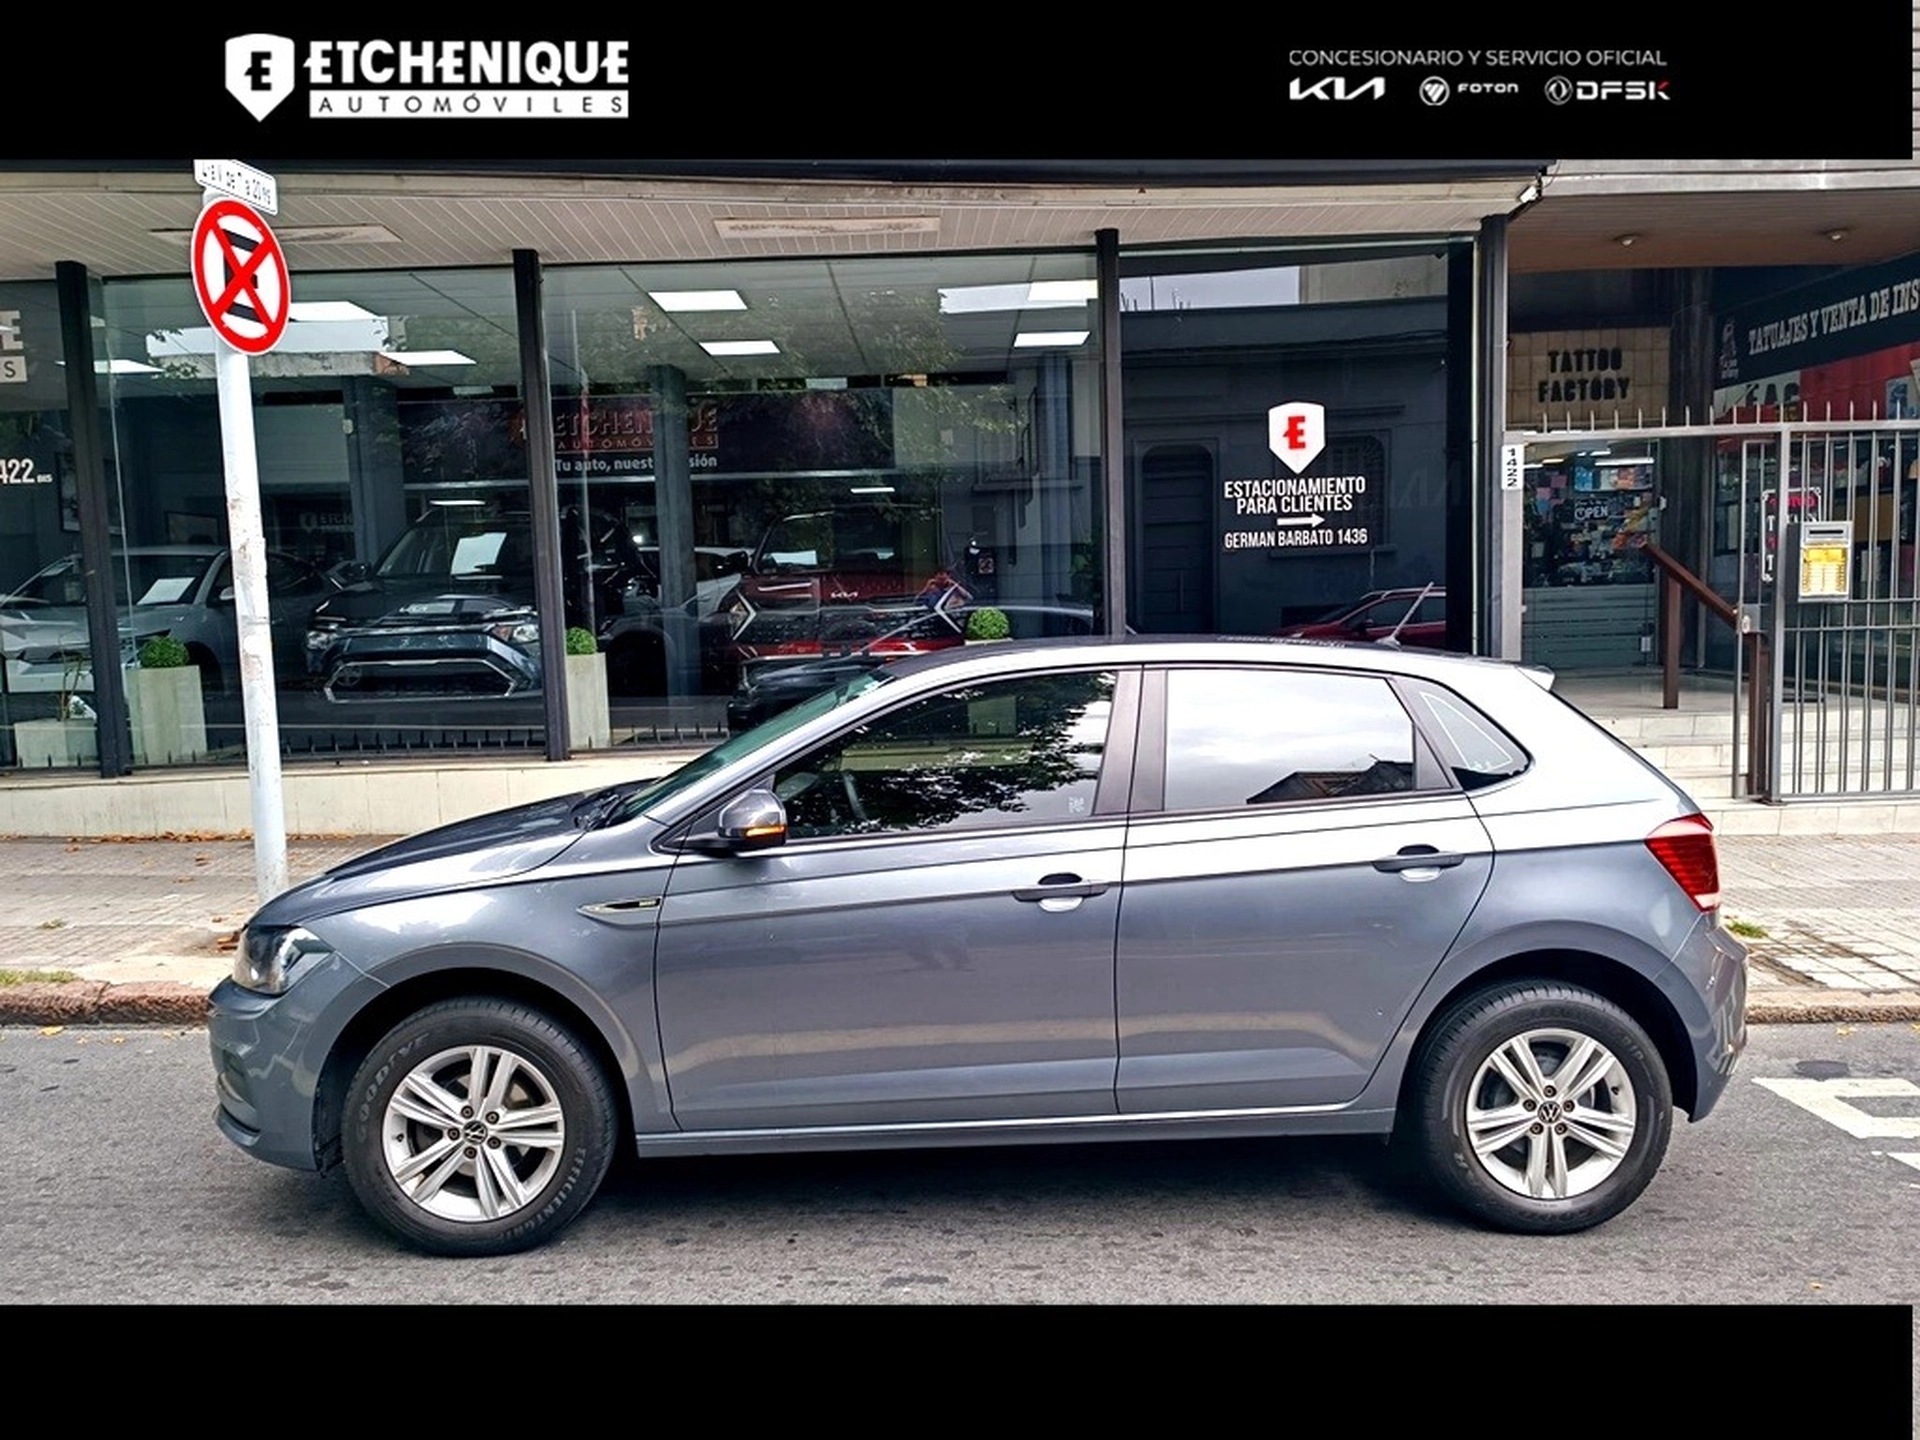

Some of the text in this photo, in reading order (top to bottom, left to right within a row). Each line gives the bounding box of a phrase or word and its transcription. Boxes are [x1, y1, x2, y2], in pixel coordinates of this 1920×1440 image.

[1749, 312, 1808, 355] TATUAJES
[1808, 309, 1820, 338] Y
[1820, 295, 1867, 334] VENTA
[1868, 287, 1890, 321] DE
[1547, 347, 1622, 374] TATTOO
[1538, 377, 1630, 403] FACTORY
[555, 458, 571, 472] Tu
[614, 457, 654, 470] nuest
[689, 455, 718, 468] sión
[1224, 476, 1366, 498] ESTACIONAMIENTO
[1237, 494, 1353, 514] PARA CLIENTES
[1224, 528, 1368, 549] GERMAN BARBATO 1436
